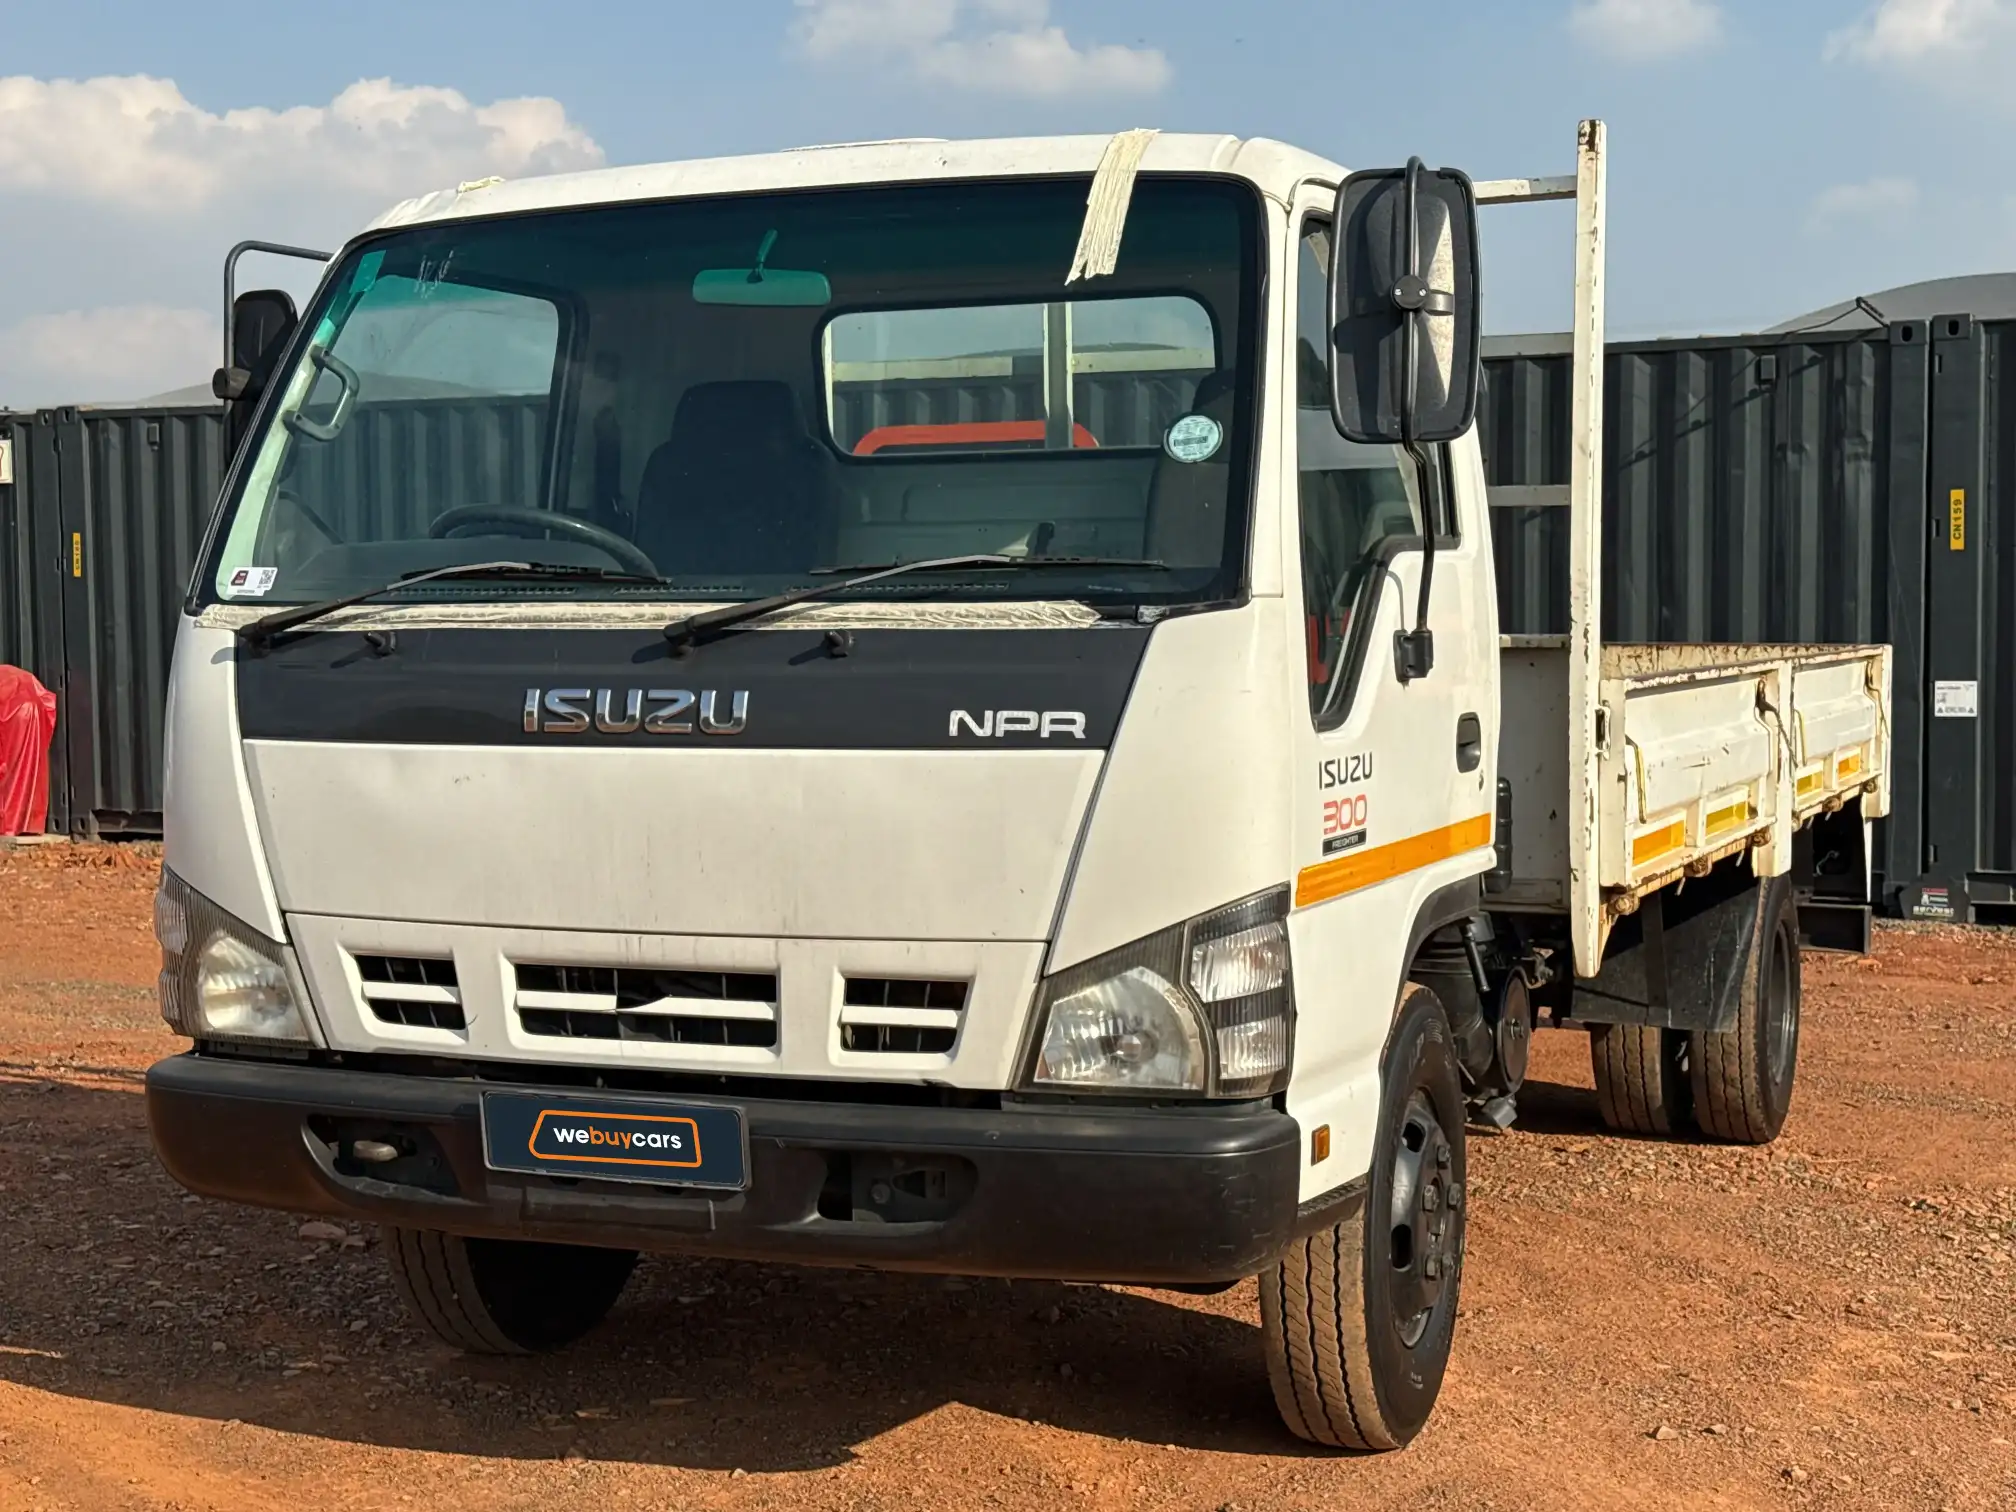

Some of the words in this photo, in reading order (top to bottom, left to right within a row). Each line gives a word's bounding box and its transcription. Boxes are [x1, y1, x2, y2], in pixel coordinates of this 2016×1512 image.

[1952, 498, 1963, 541] CN159
[523, 688, 750, 735] ISUZU
[949, 709, 1087, 739] NPR
[1318, 751, 1373, 791] ISUZU
[1323, 793, 1368, 836] 300
[553, 1125, 683, 1150] webuycars
